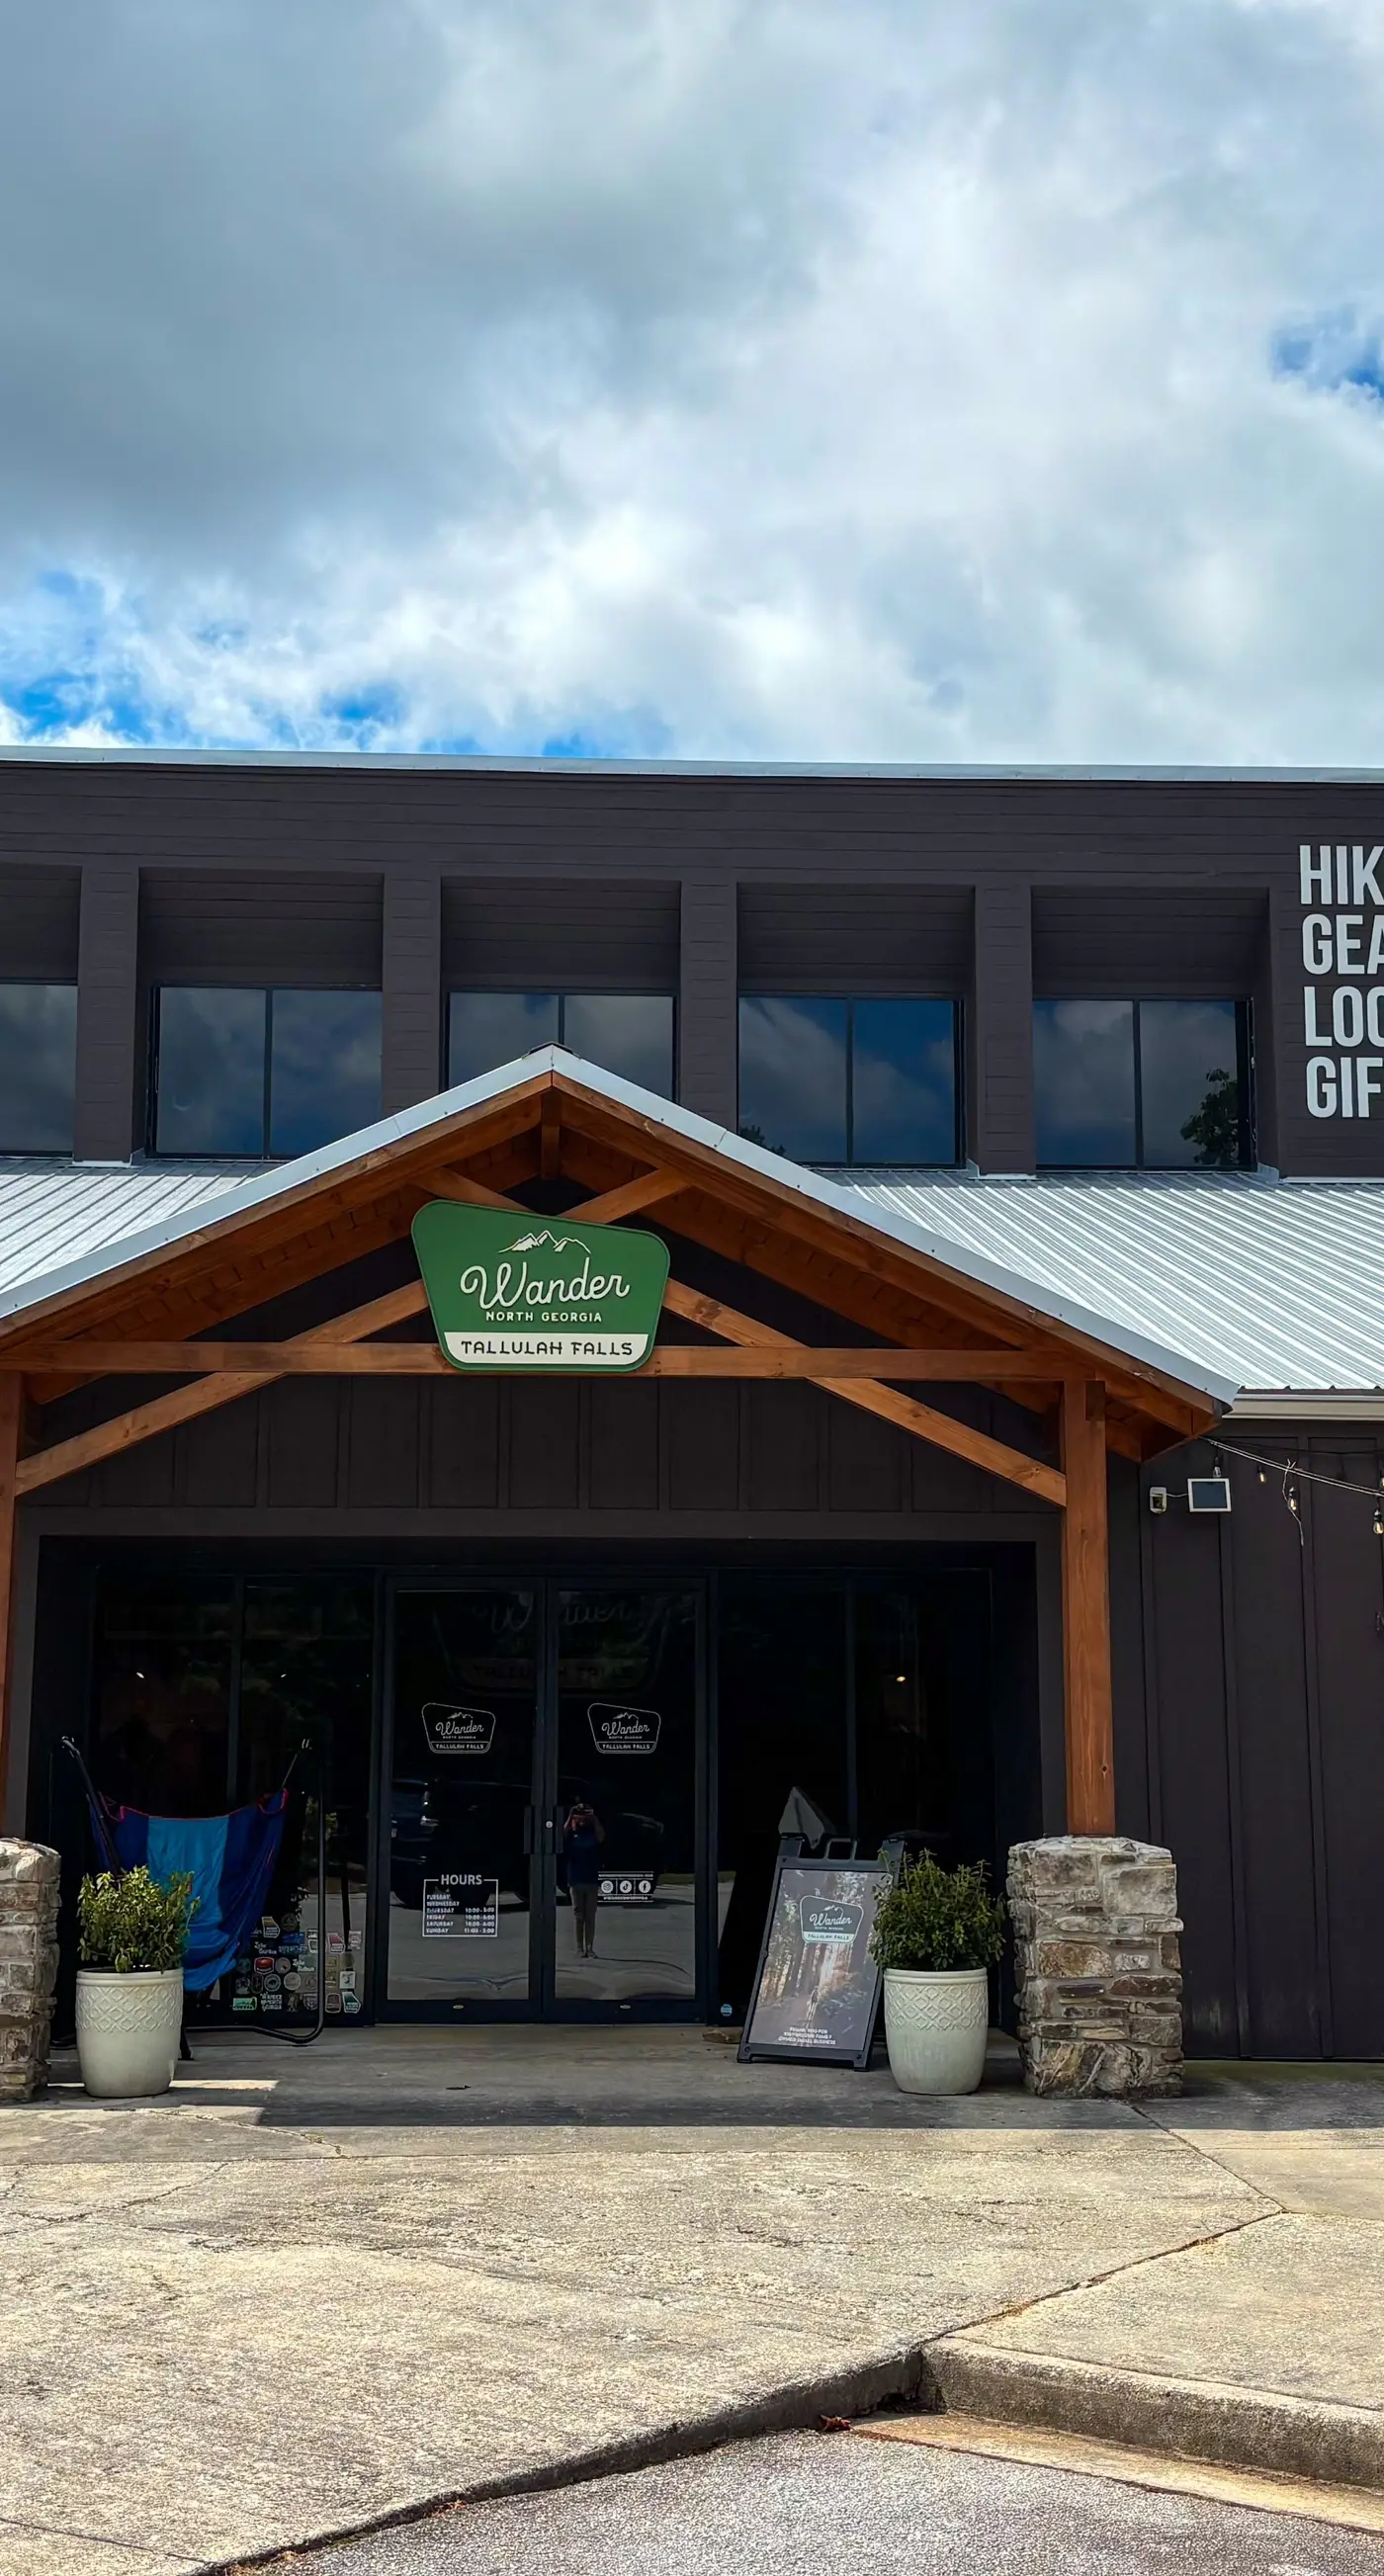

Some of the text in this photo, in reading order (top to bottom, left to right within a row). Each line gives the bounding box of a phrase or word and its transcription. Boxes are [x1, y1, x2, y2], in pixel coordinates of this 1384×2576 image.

[1299, 845, 1384, 905] HIK
[1306, 1056, 1383, 1118] GIF
[460, 1256, 631, 1310] Wander
[485, 1311, 602, 1323] NORTH GEORGIA
[461, 1340, 633, 1356] TALLULAH FALLS
[435, 1719, 484, 1736] Wander
[601, 1719, 650, 1736] Wander
[441, 1874, 482, 1885] HOURS
[809, 1909, 852, 1927] Wander
